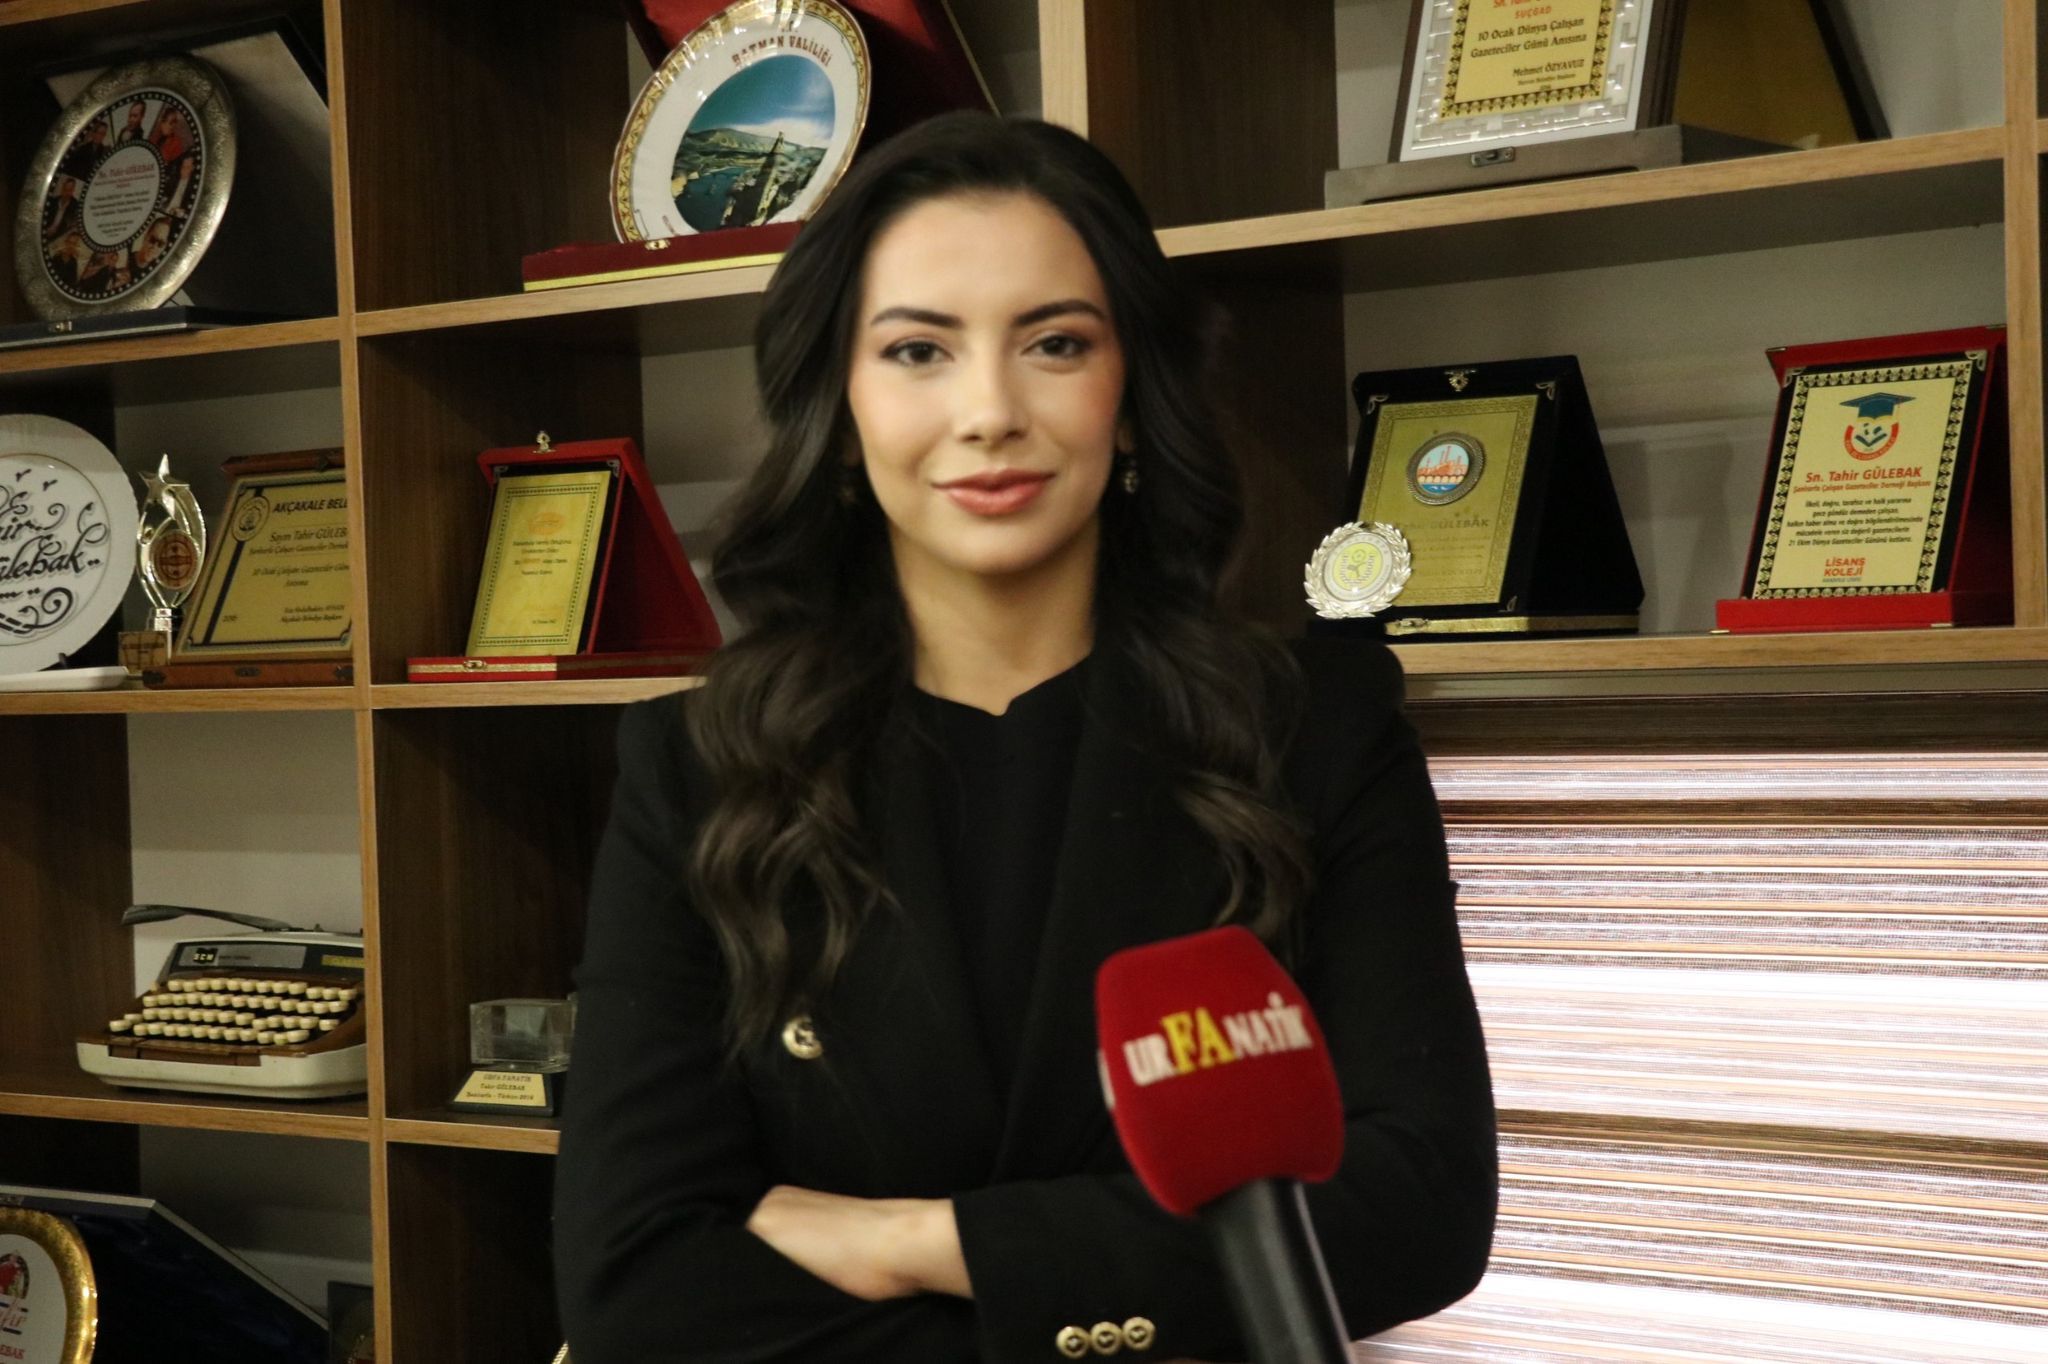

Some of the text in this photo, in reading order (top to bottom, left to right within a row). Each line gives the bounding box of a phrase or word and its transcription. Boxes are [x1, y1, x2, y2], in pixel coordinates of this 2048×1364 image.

[1478, 18, 1584, 41] 10 Ocak Dünya Çalışan
[789, 36, 833, 67] VALİLİĞİ
[1471, 34, 1587, 58] Gazeteciler Günü Anısına
[1513, 66, 1543, 77] Mehmet
[1805, 466, 1923, 483] Sn. Tahir GÜLEBAK
[272, 499, 326, 515] AKÇAKALE
[1825, 557, 1866, 567] LİSANS
[1824, 567, 1864, 577] KOLEJİ
